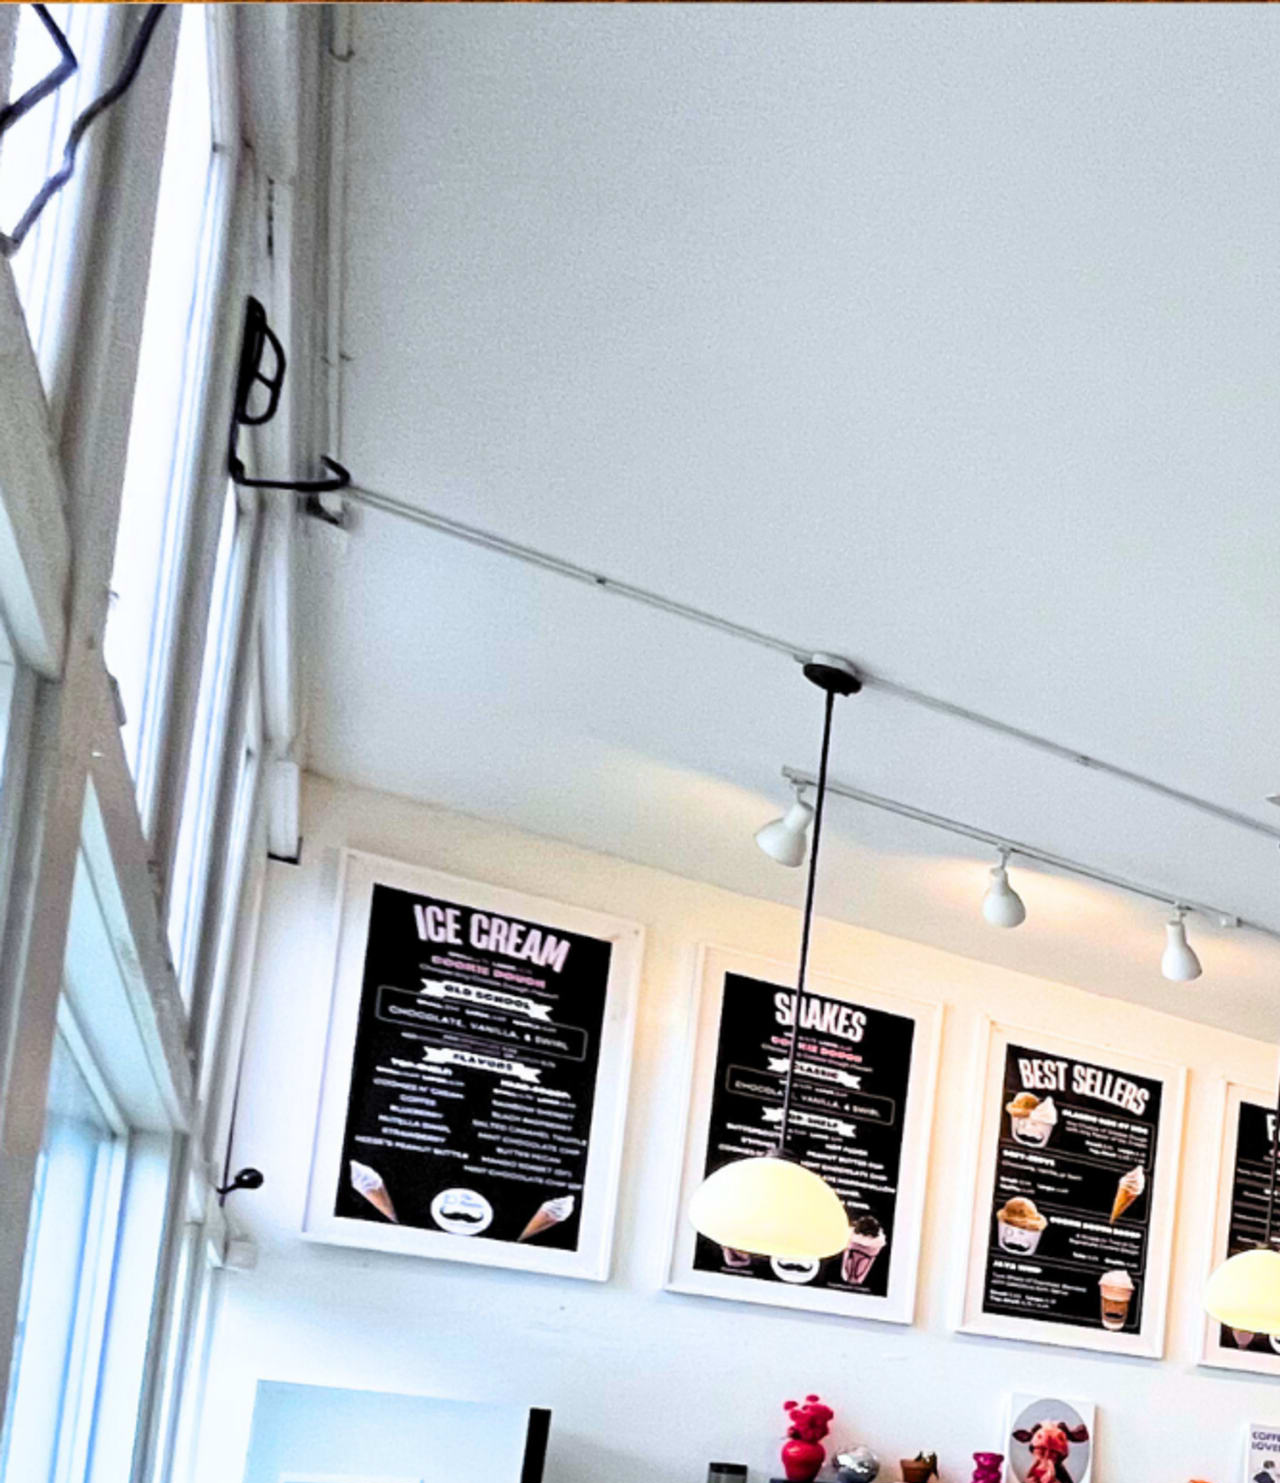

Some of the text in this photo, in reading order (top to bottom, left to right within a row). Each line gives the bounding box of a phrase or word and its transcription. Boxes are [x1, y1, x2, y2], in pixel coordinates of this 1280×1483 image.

[413, 904, 463, 945] ICE
[469, 913, 571, 973] CREAM
[444, 985, 531, 1010] OLD SCHOOL
[774, 992, 867, 1042] SHAKES
[1017, 1058, 1150, 1116] BEST SELLERS
